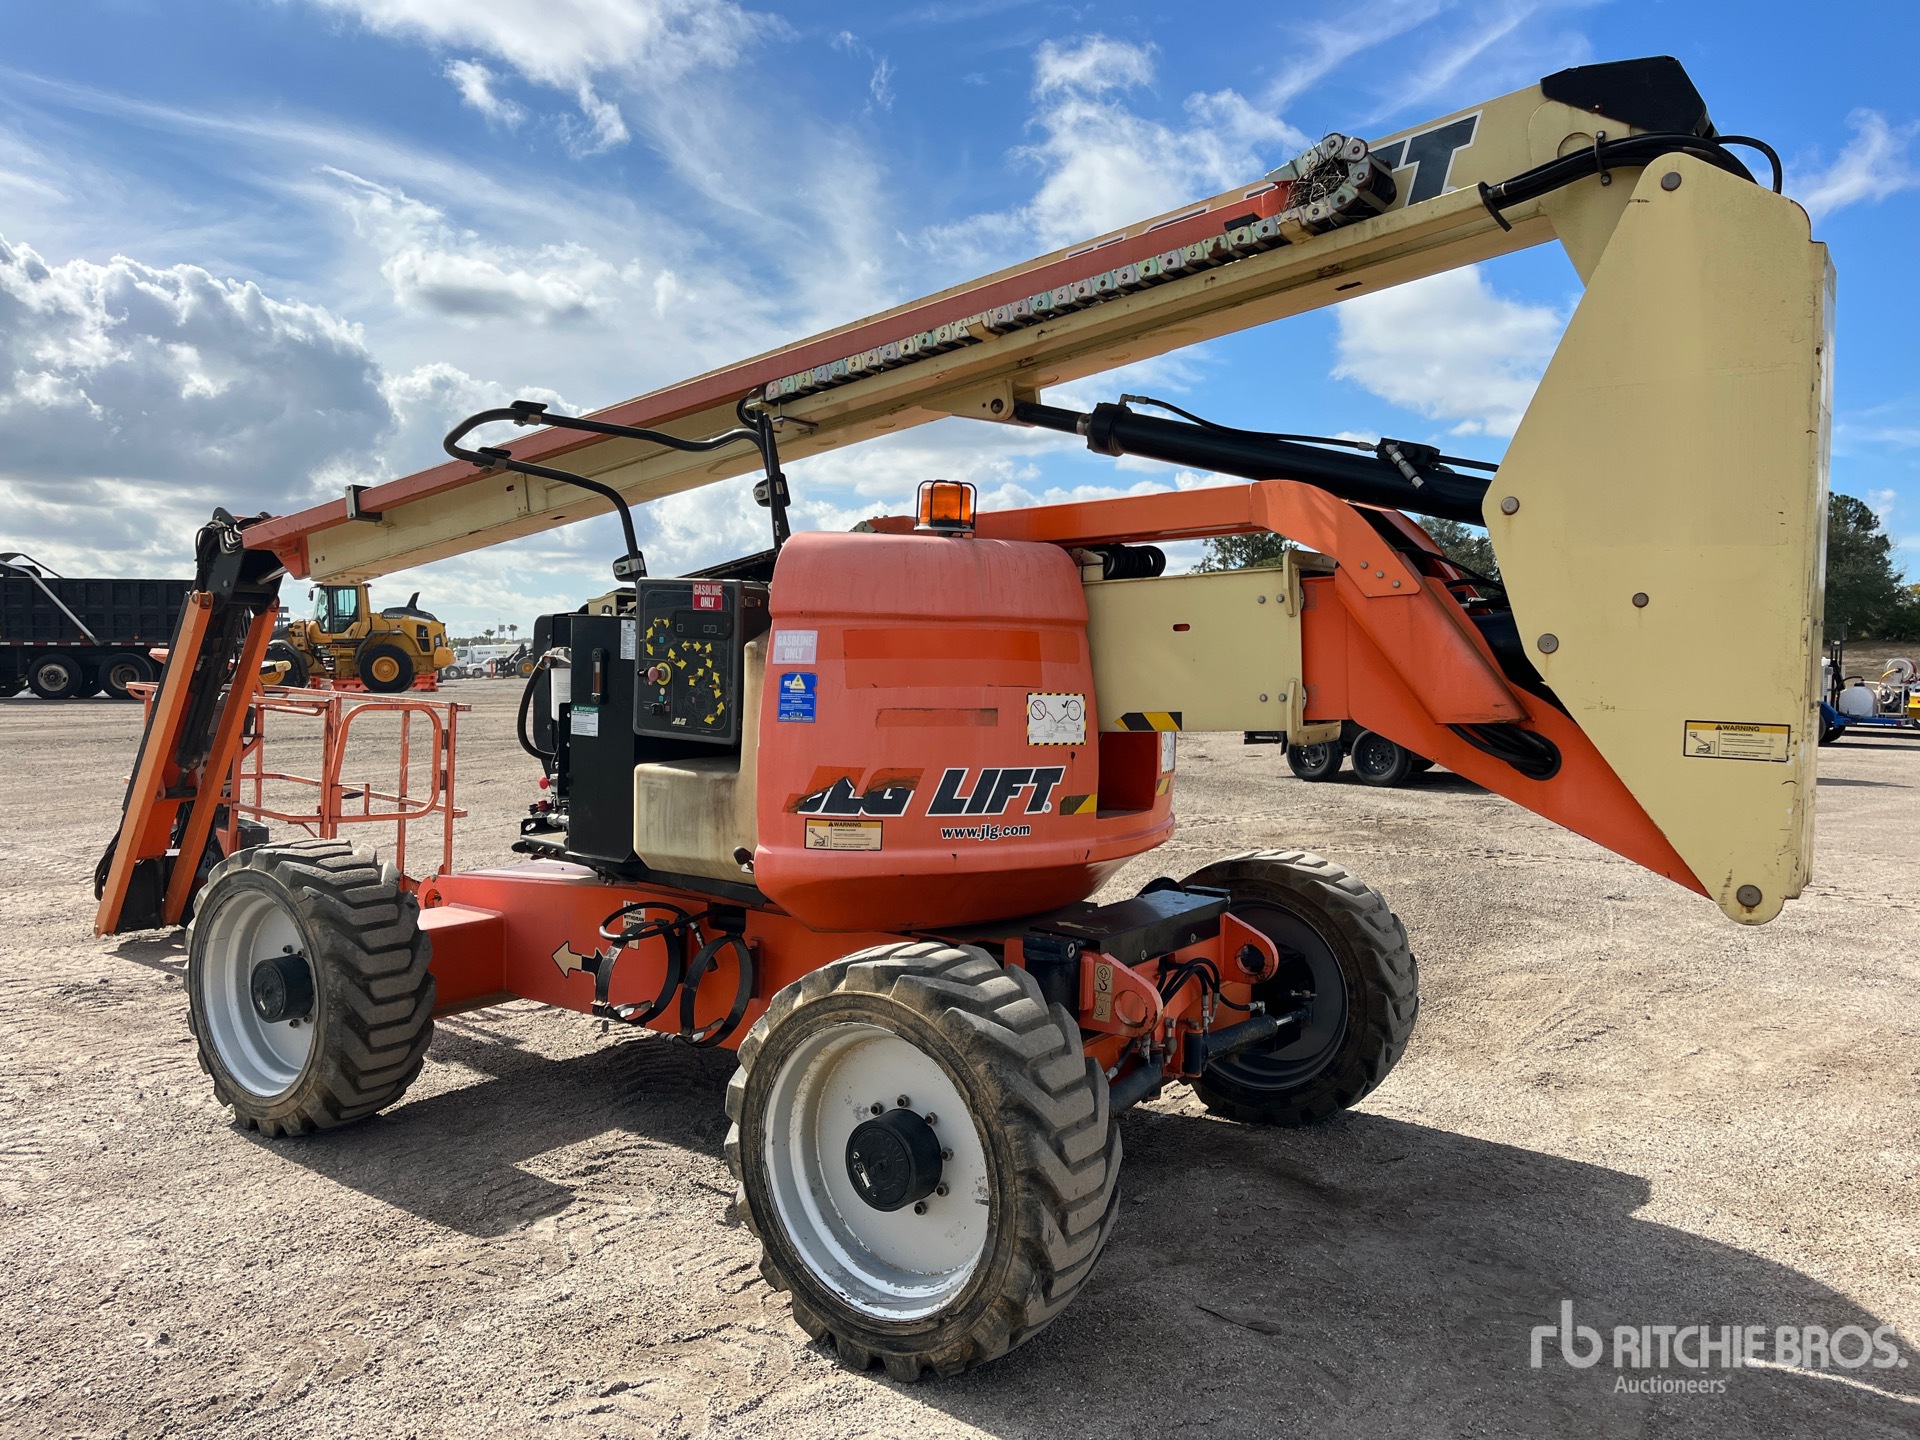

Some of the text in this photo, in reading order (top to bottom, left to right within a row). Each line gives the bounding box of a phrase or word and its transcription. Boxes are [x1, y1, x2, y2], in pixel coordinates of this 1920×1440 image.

[694, 584, 722, 596] GASOLINE
[700, 597, 715, 608] ONLY
[777, 634, 813, 647] GASOLINE
[784, 647, 803, 659] ONLY
[672, 717, 687, 725] JLG
[941, 824, 1031, 841] www.jlg.com
